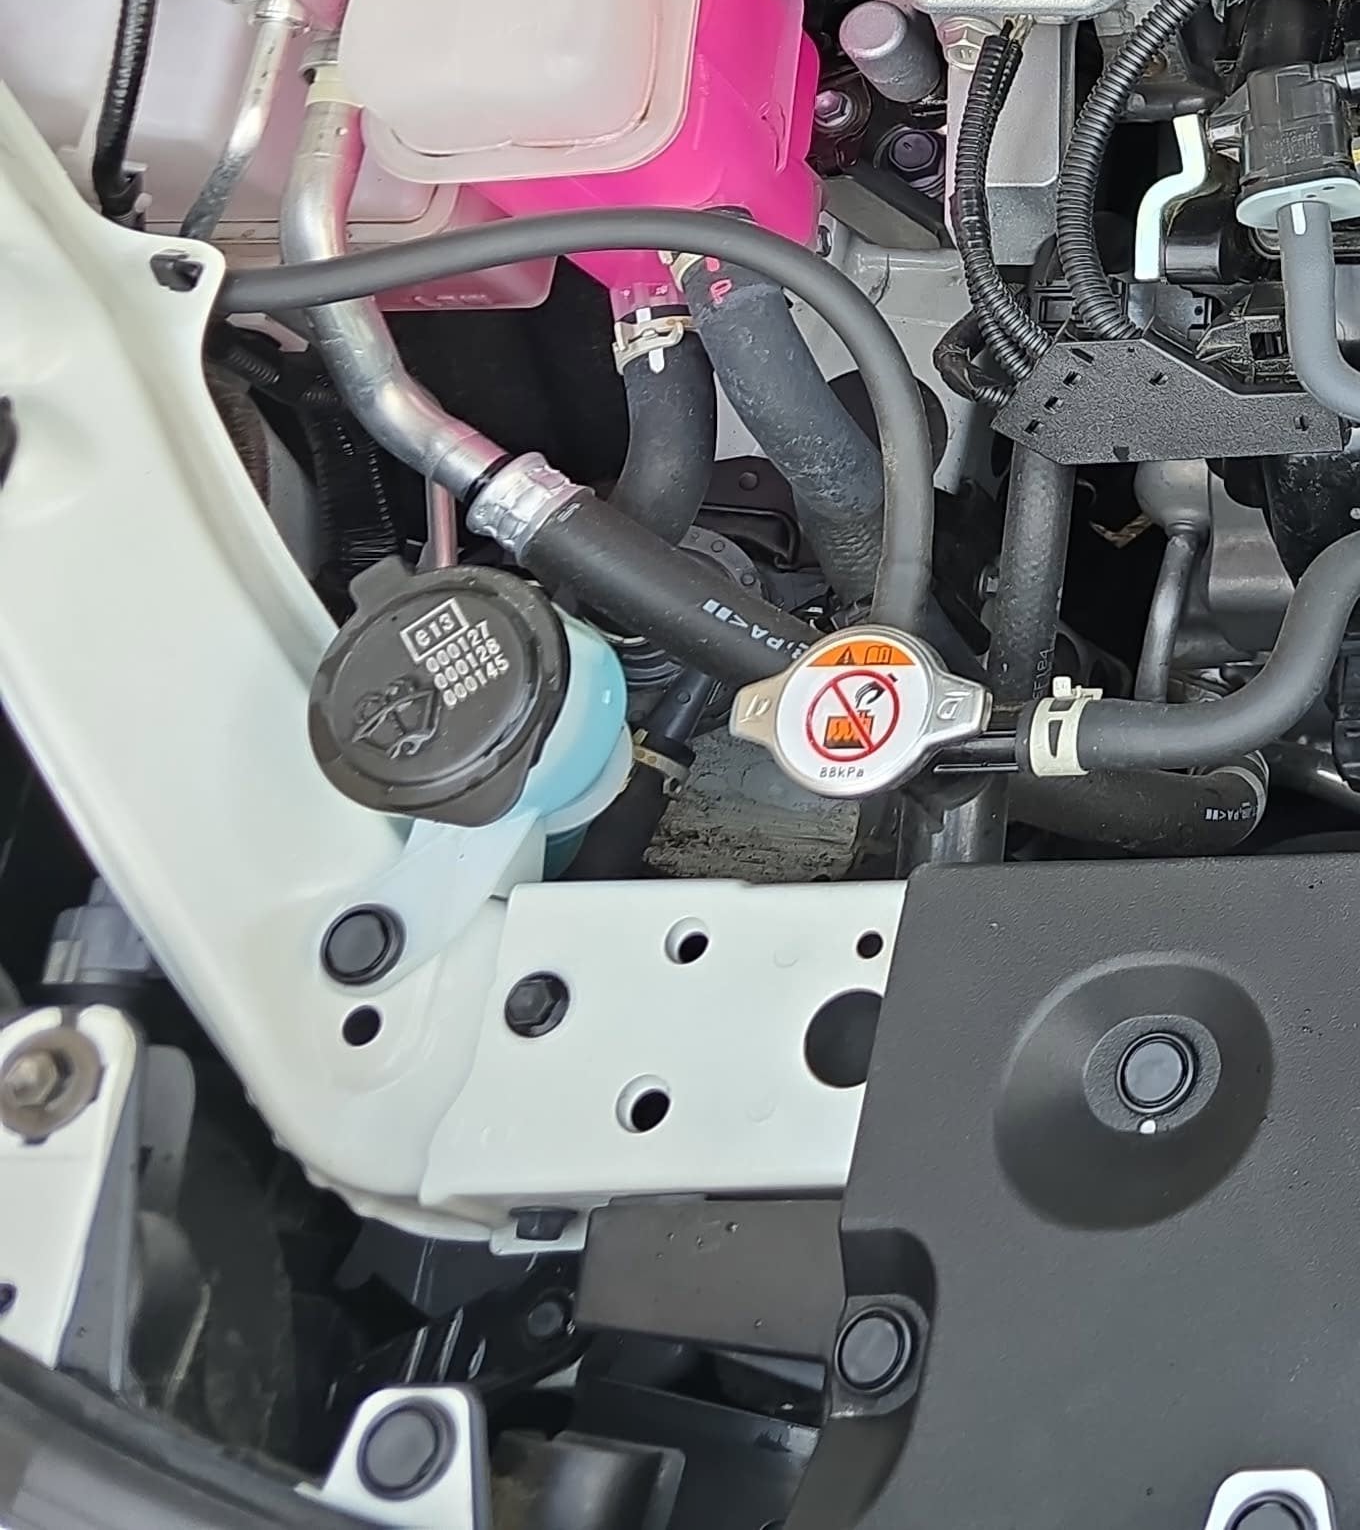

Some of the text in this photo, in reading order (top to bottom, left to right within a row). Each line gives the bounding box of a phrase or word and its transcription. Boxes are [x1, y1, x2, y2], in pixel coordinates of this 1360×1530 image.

[414, 612, 456, 647] e13
[426, 620, 490, 673] 000127
[434, 637, 501, 690] 000128
[443, 653, 510, 707] 000145
